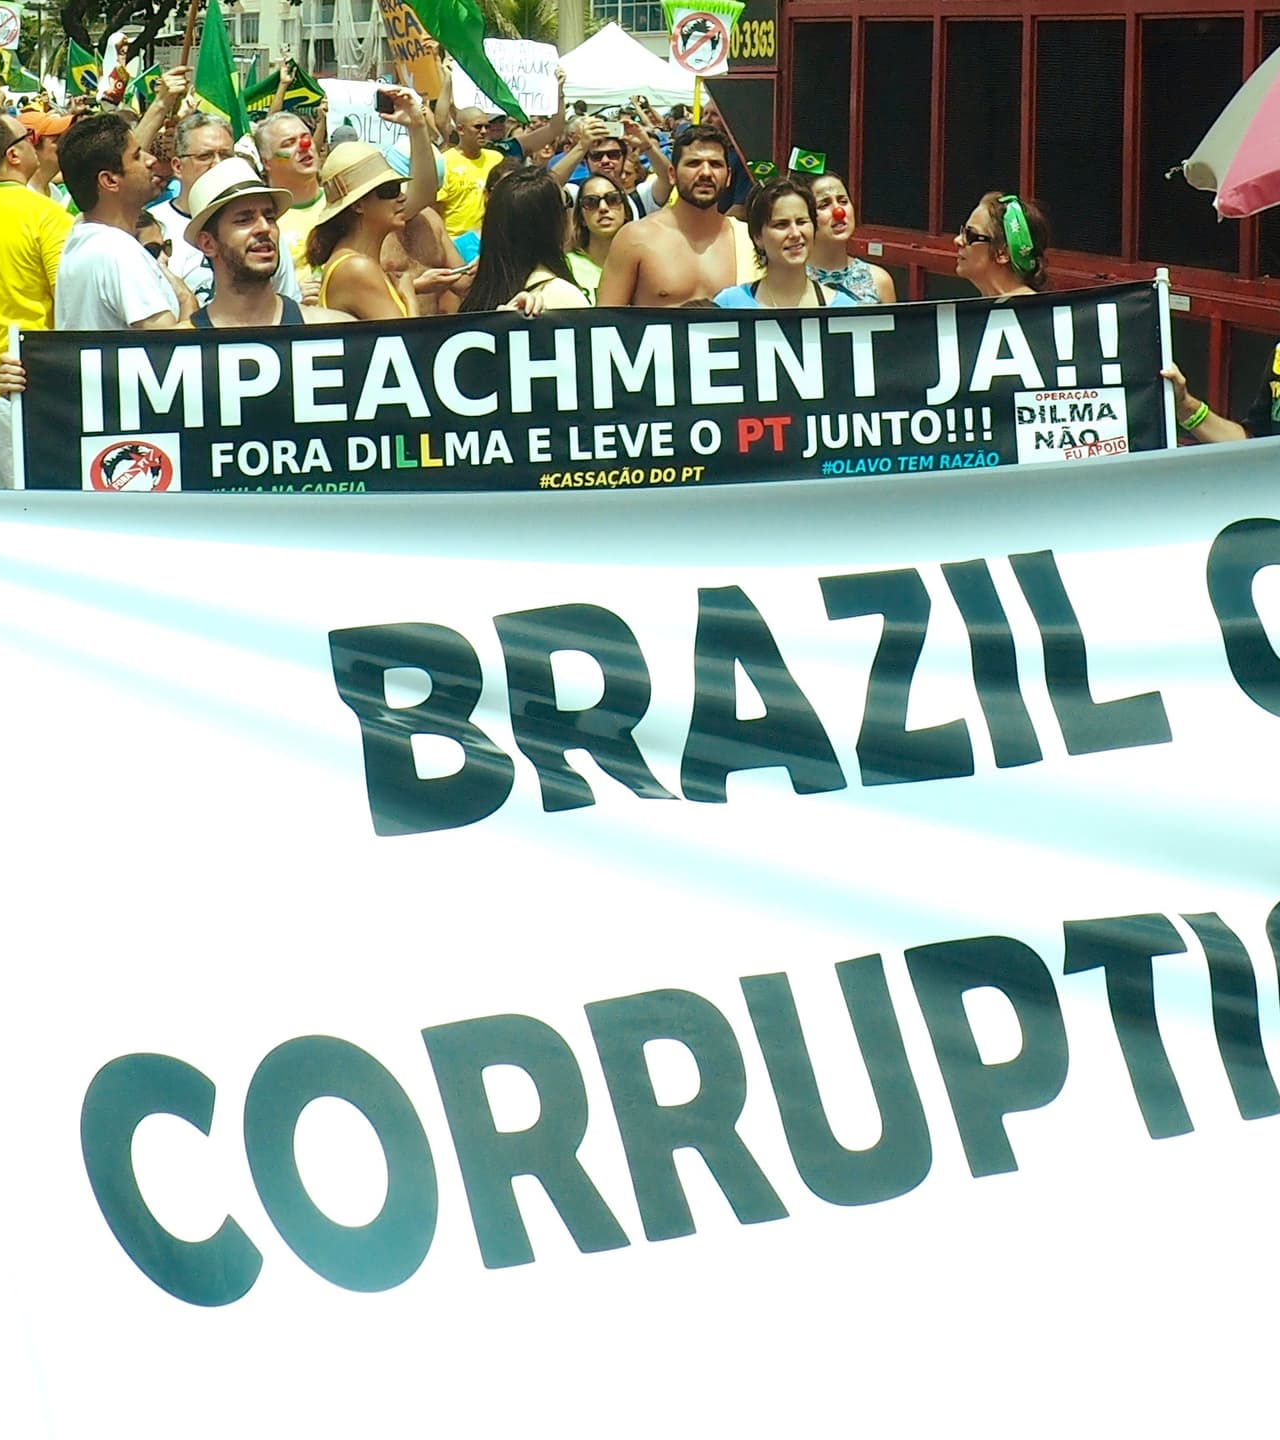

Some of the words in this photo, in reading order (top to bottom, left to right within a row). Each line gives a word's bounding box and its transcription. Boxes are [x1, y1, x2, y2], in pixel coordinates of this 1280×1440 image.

[80, 314, 896, 433] IMPEACHMENT
[925, 302, 1122, 407] JA!!
[1035, 390, 1099, 402] OPERAÇÃO
[1016, 402, 1119, 425] DILMA
[210, 438, 333, 479] FORA
[347, 429, 514, 472] DILLMA
[528, 427, 552, 463] E
[569, 421, 674, 461] LEVE
[689, 418, 722, 455] O
[737, 415, 792, 453] PT
[802, 406, 993, 458] JUNTO!!!
[1034, 425, 1101, 450] NÃO
[1087, 439, 1127, 458] APOIO
[822, 457, 892, 475] #OLAVO
[897, 454, 939, 471] TEM
[940, 450, 1000, 469] RAZÃO
[539, 466, 645, 489] #CASSAÇÃO
[649, 468, 676, 485] DO
[681, 465, 705, 482] PT
[328, 548, 1173, 837] BRAZIL
